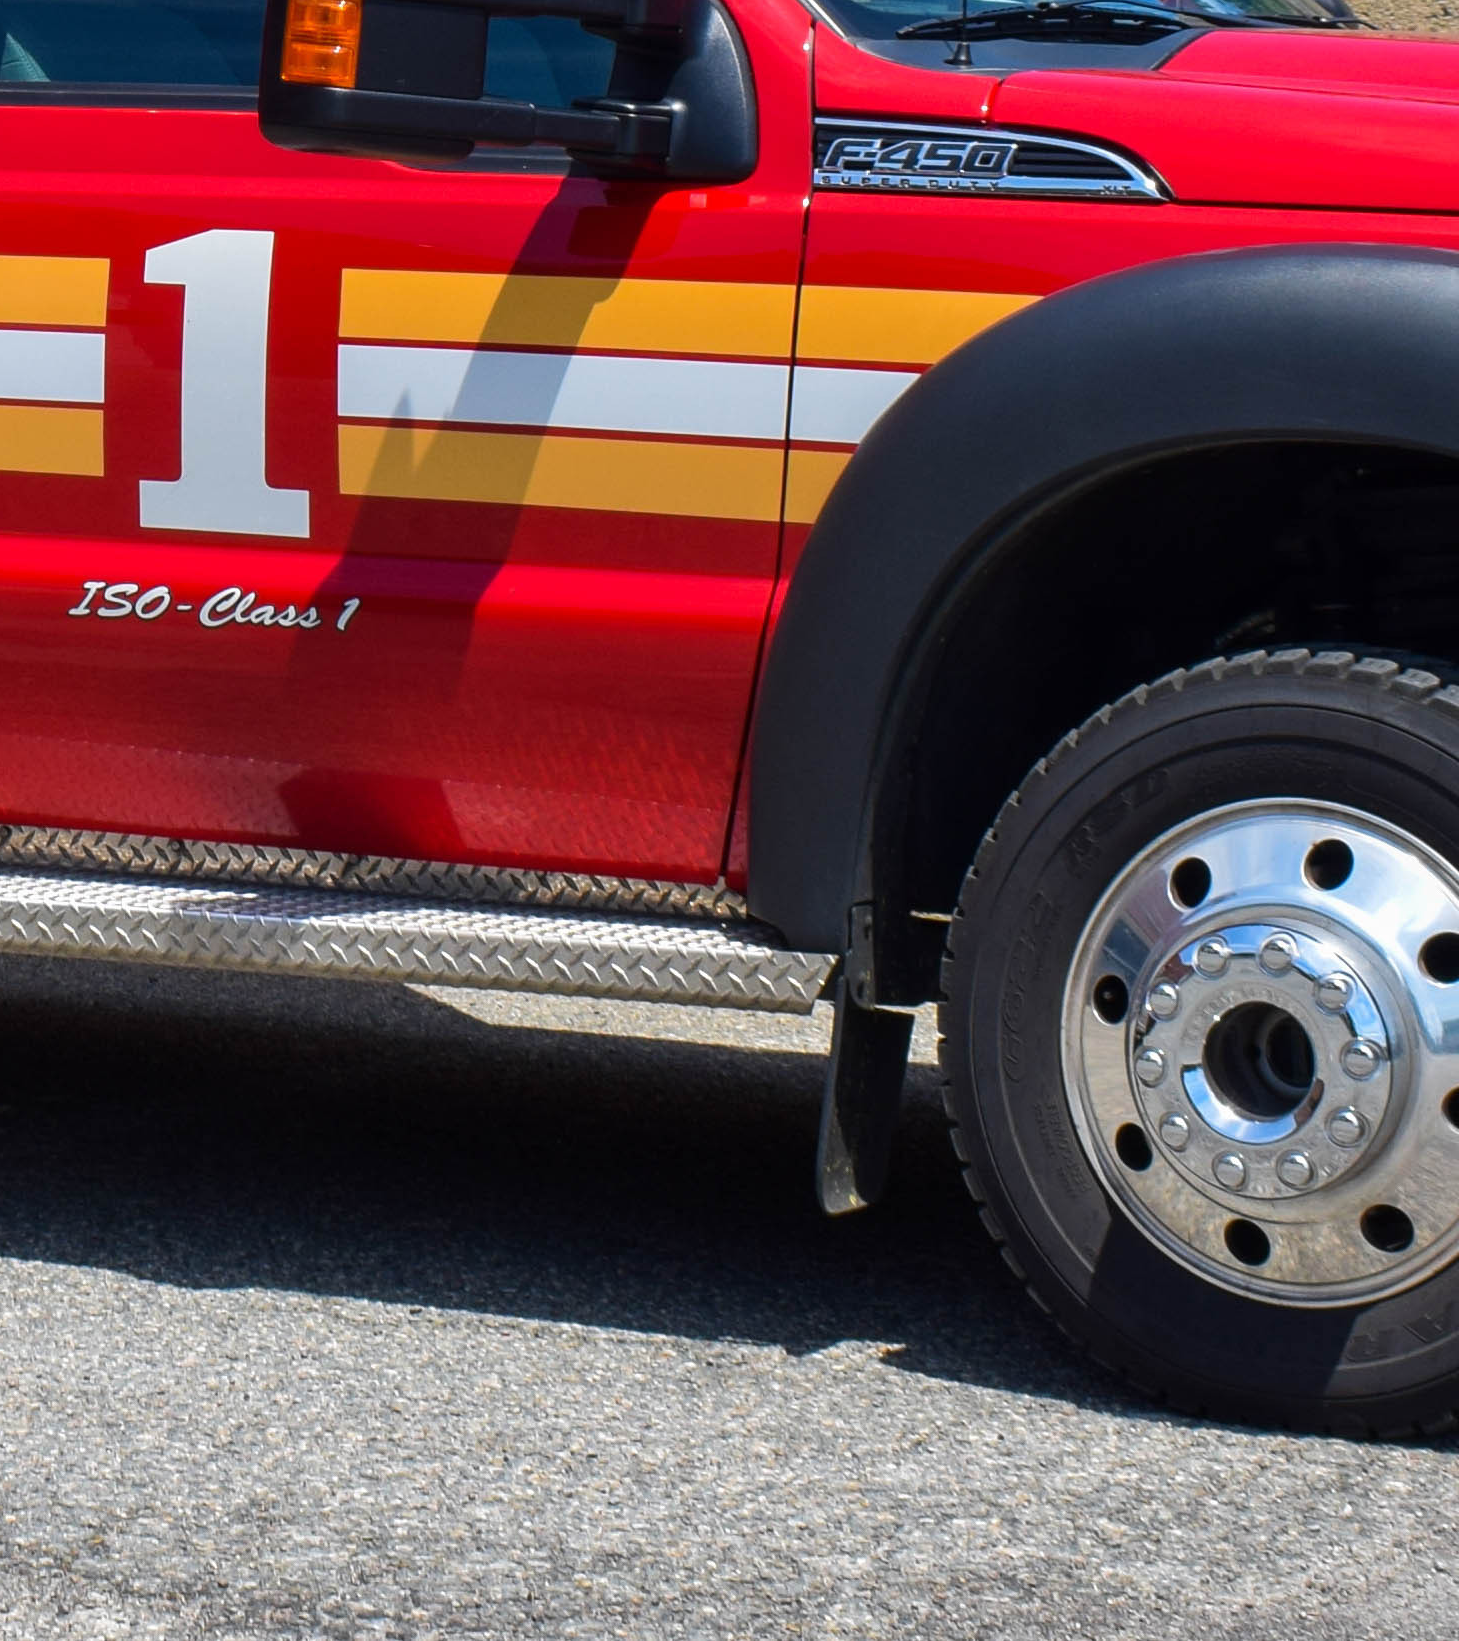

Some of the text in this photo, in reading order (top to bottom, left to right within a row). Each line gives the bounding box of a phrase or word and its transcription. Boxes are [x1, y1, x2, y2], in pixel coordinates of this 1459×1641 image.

[821, 175, 1001, 192] SUPER DUTY
[139, 228, 311, 539] 1
[336, 596, 362, 631] 1
